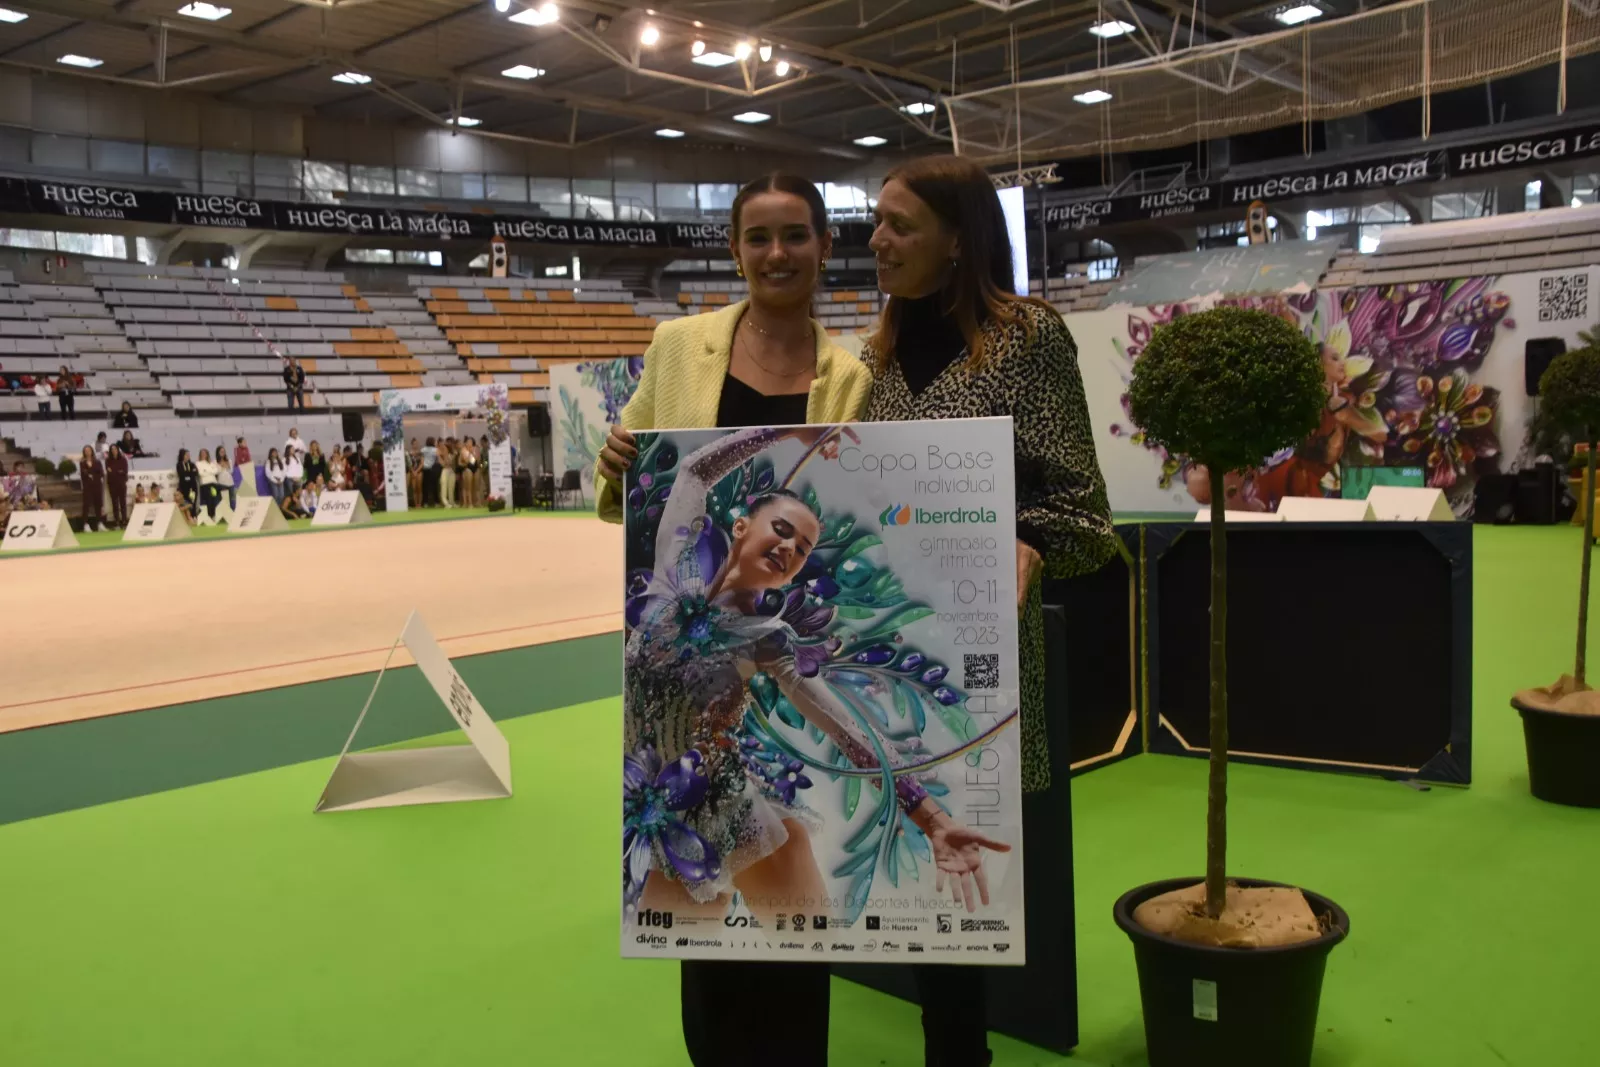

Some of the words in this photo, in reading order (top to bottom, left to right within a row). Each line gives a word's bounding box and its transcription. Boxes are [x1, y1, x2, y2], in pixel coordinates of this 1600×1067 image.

[1459, 138, 1566, 170] Huesca
[41, 184, 139, 208] Huesca
[1233, 175, 1316, 202] Huesca
[1323, 170, 1348, 189] La
[176, 195, 262, 217] Huesca
[1140, 186, 1210, 209] Huesca
[65, 206, 81, 217] La
[84, 208, 125, 219] Magia
[193, 215, 208, 225] La
[210, 217, 247, 228] Magia
[287, 209, 374, 229] Huesca
[379, 215, 403, 231] La
[408, 216, 471, 234] Magia
[1046, 201, 1112, 222] Huesca
[493, 221, 569, 239] Huesca
[573, 225, 595, 240] La
[600, 227, 657, 243] Magia
[839, 447, 917, 479] Copa
[927, 445, 994, 471] Base
[914, 474, 995, 494] individual
[321, 500, 351, 512] divina
[915, 507, 997, 524] Iberdrola
[919, 536, 997, 557] gimnasia
[952, 579, 997, 605] 10-11
[937, 610, 999, 623] noviembre
[954, 626, 999, 645] 2023
[964, 695, 1000, 826] HUESCA
[637, 908, 673, 929] rfeg
[882, 915, 929, 924] Ayuntamiento
[636, 933, 667, 944] divina
[690, 939, 722, 948] Iberdrola
